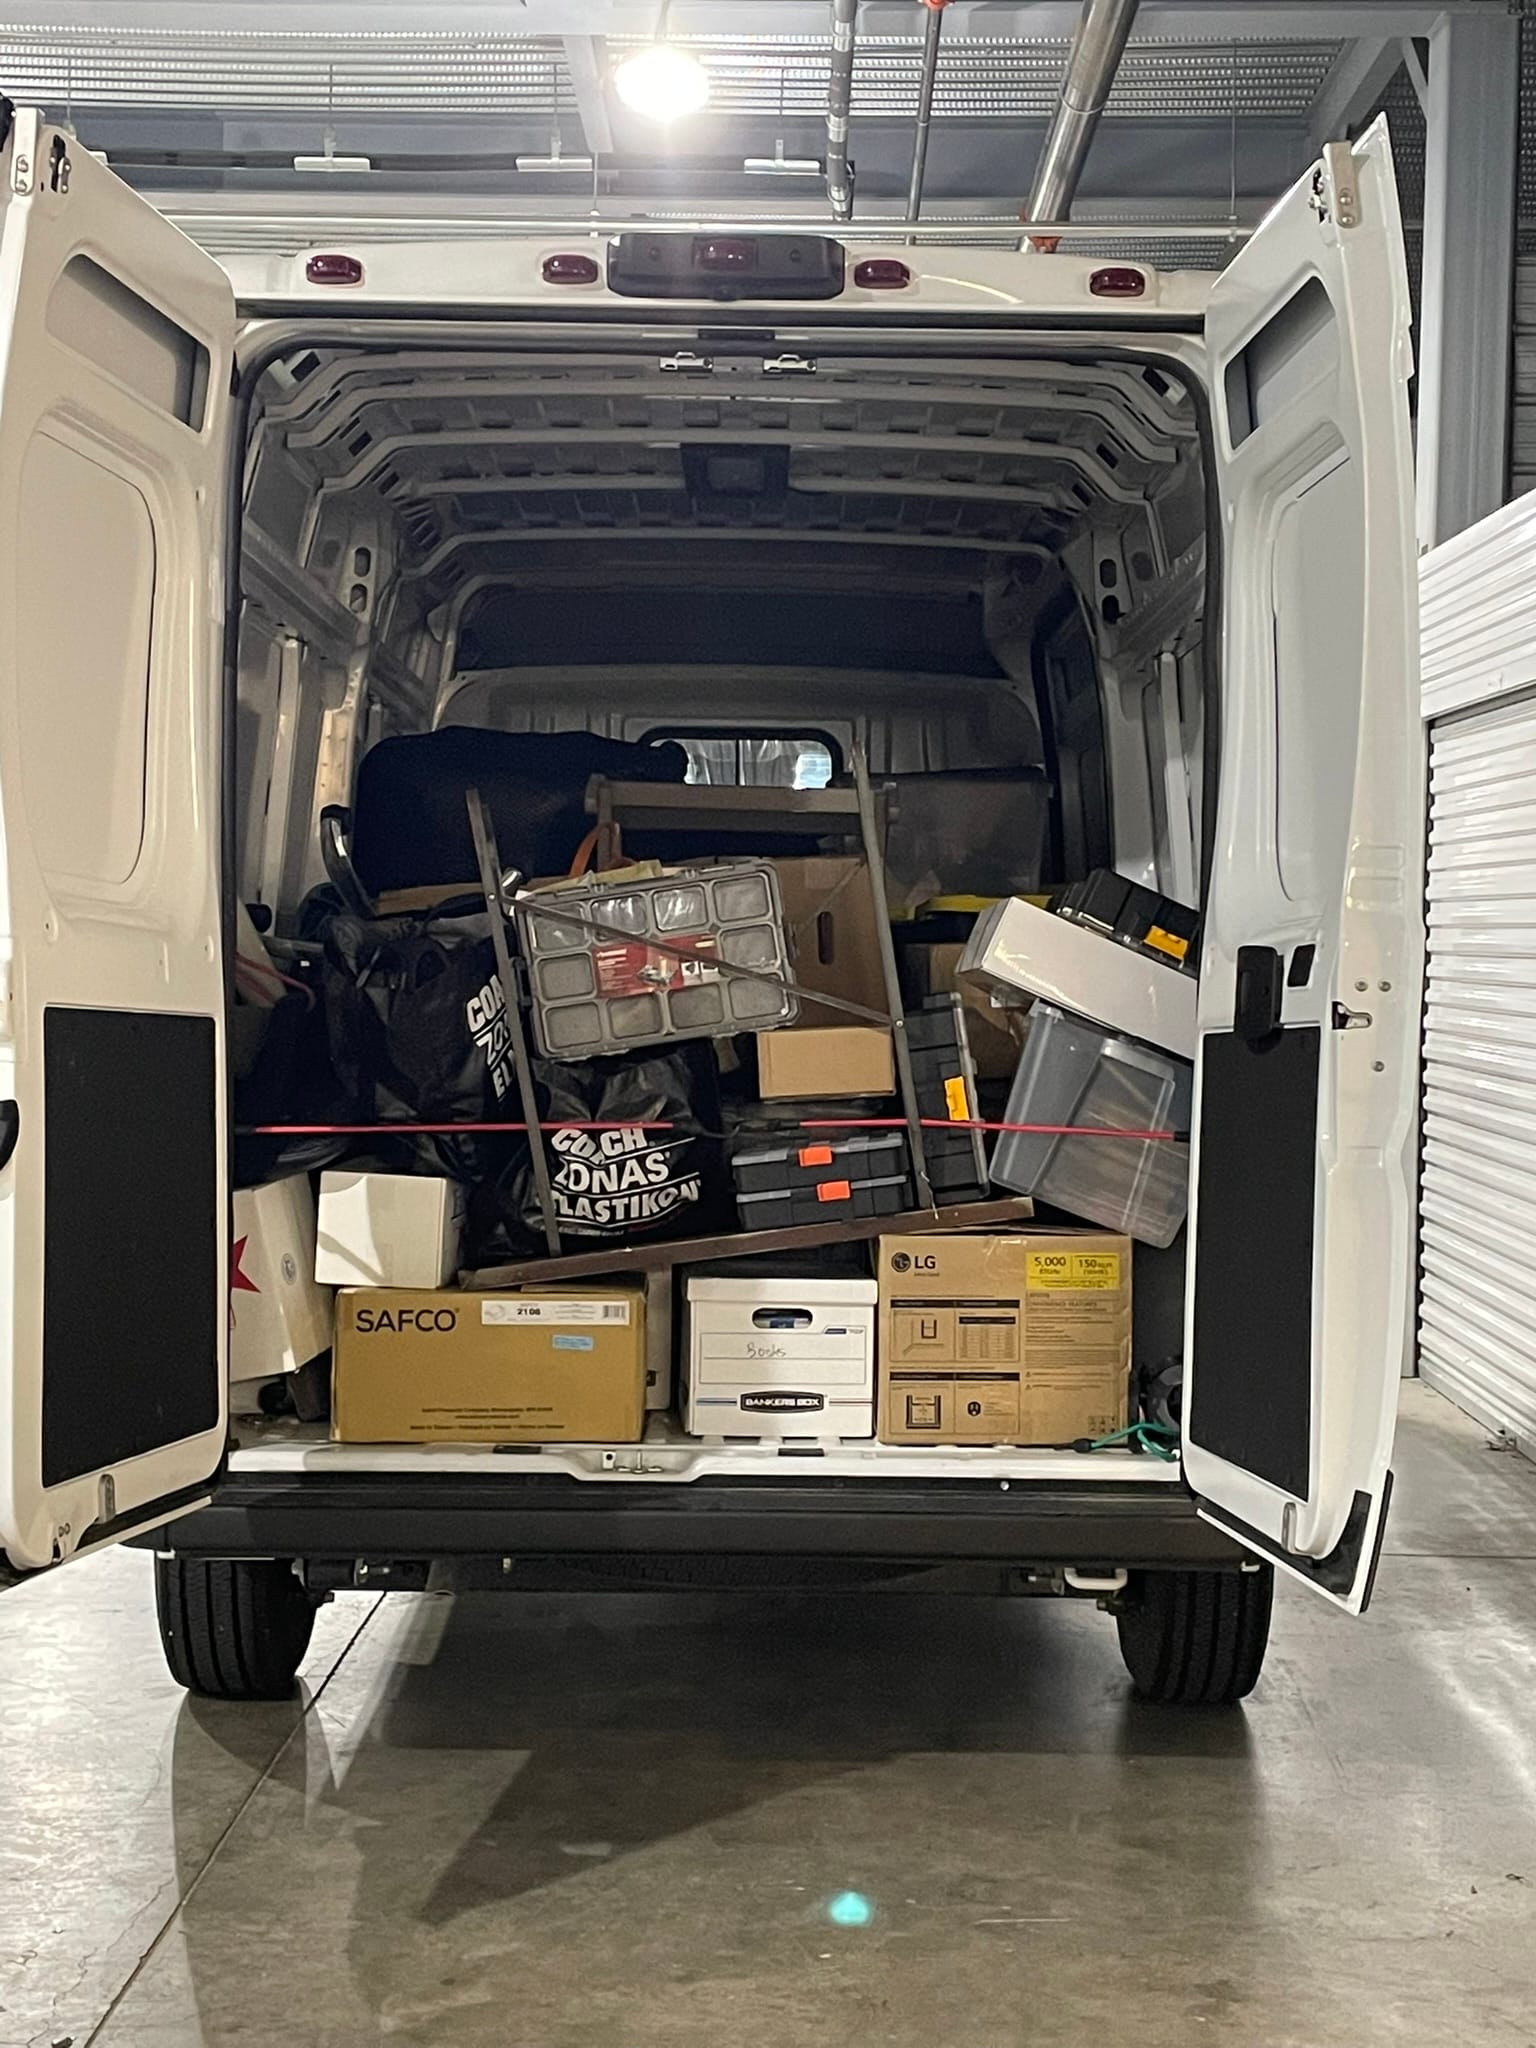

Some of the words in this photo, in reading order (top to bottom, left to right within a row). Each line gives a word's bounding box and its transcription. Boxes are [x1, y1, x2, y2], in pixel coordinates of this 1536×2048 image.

[467, 974, 505, 1032] COA
[914, 1255, 936, 1269] LG
[1034, 1256, 1066, 1268] 5,000
[356, 1309, 457, 1332] SAFCO
[797, 1398, 820, 1407] BOX
